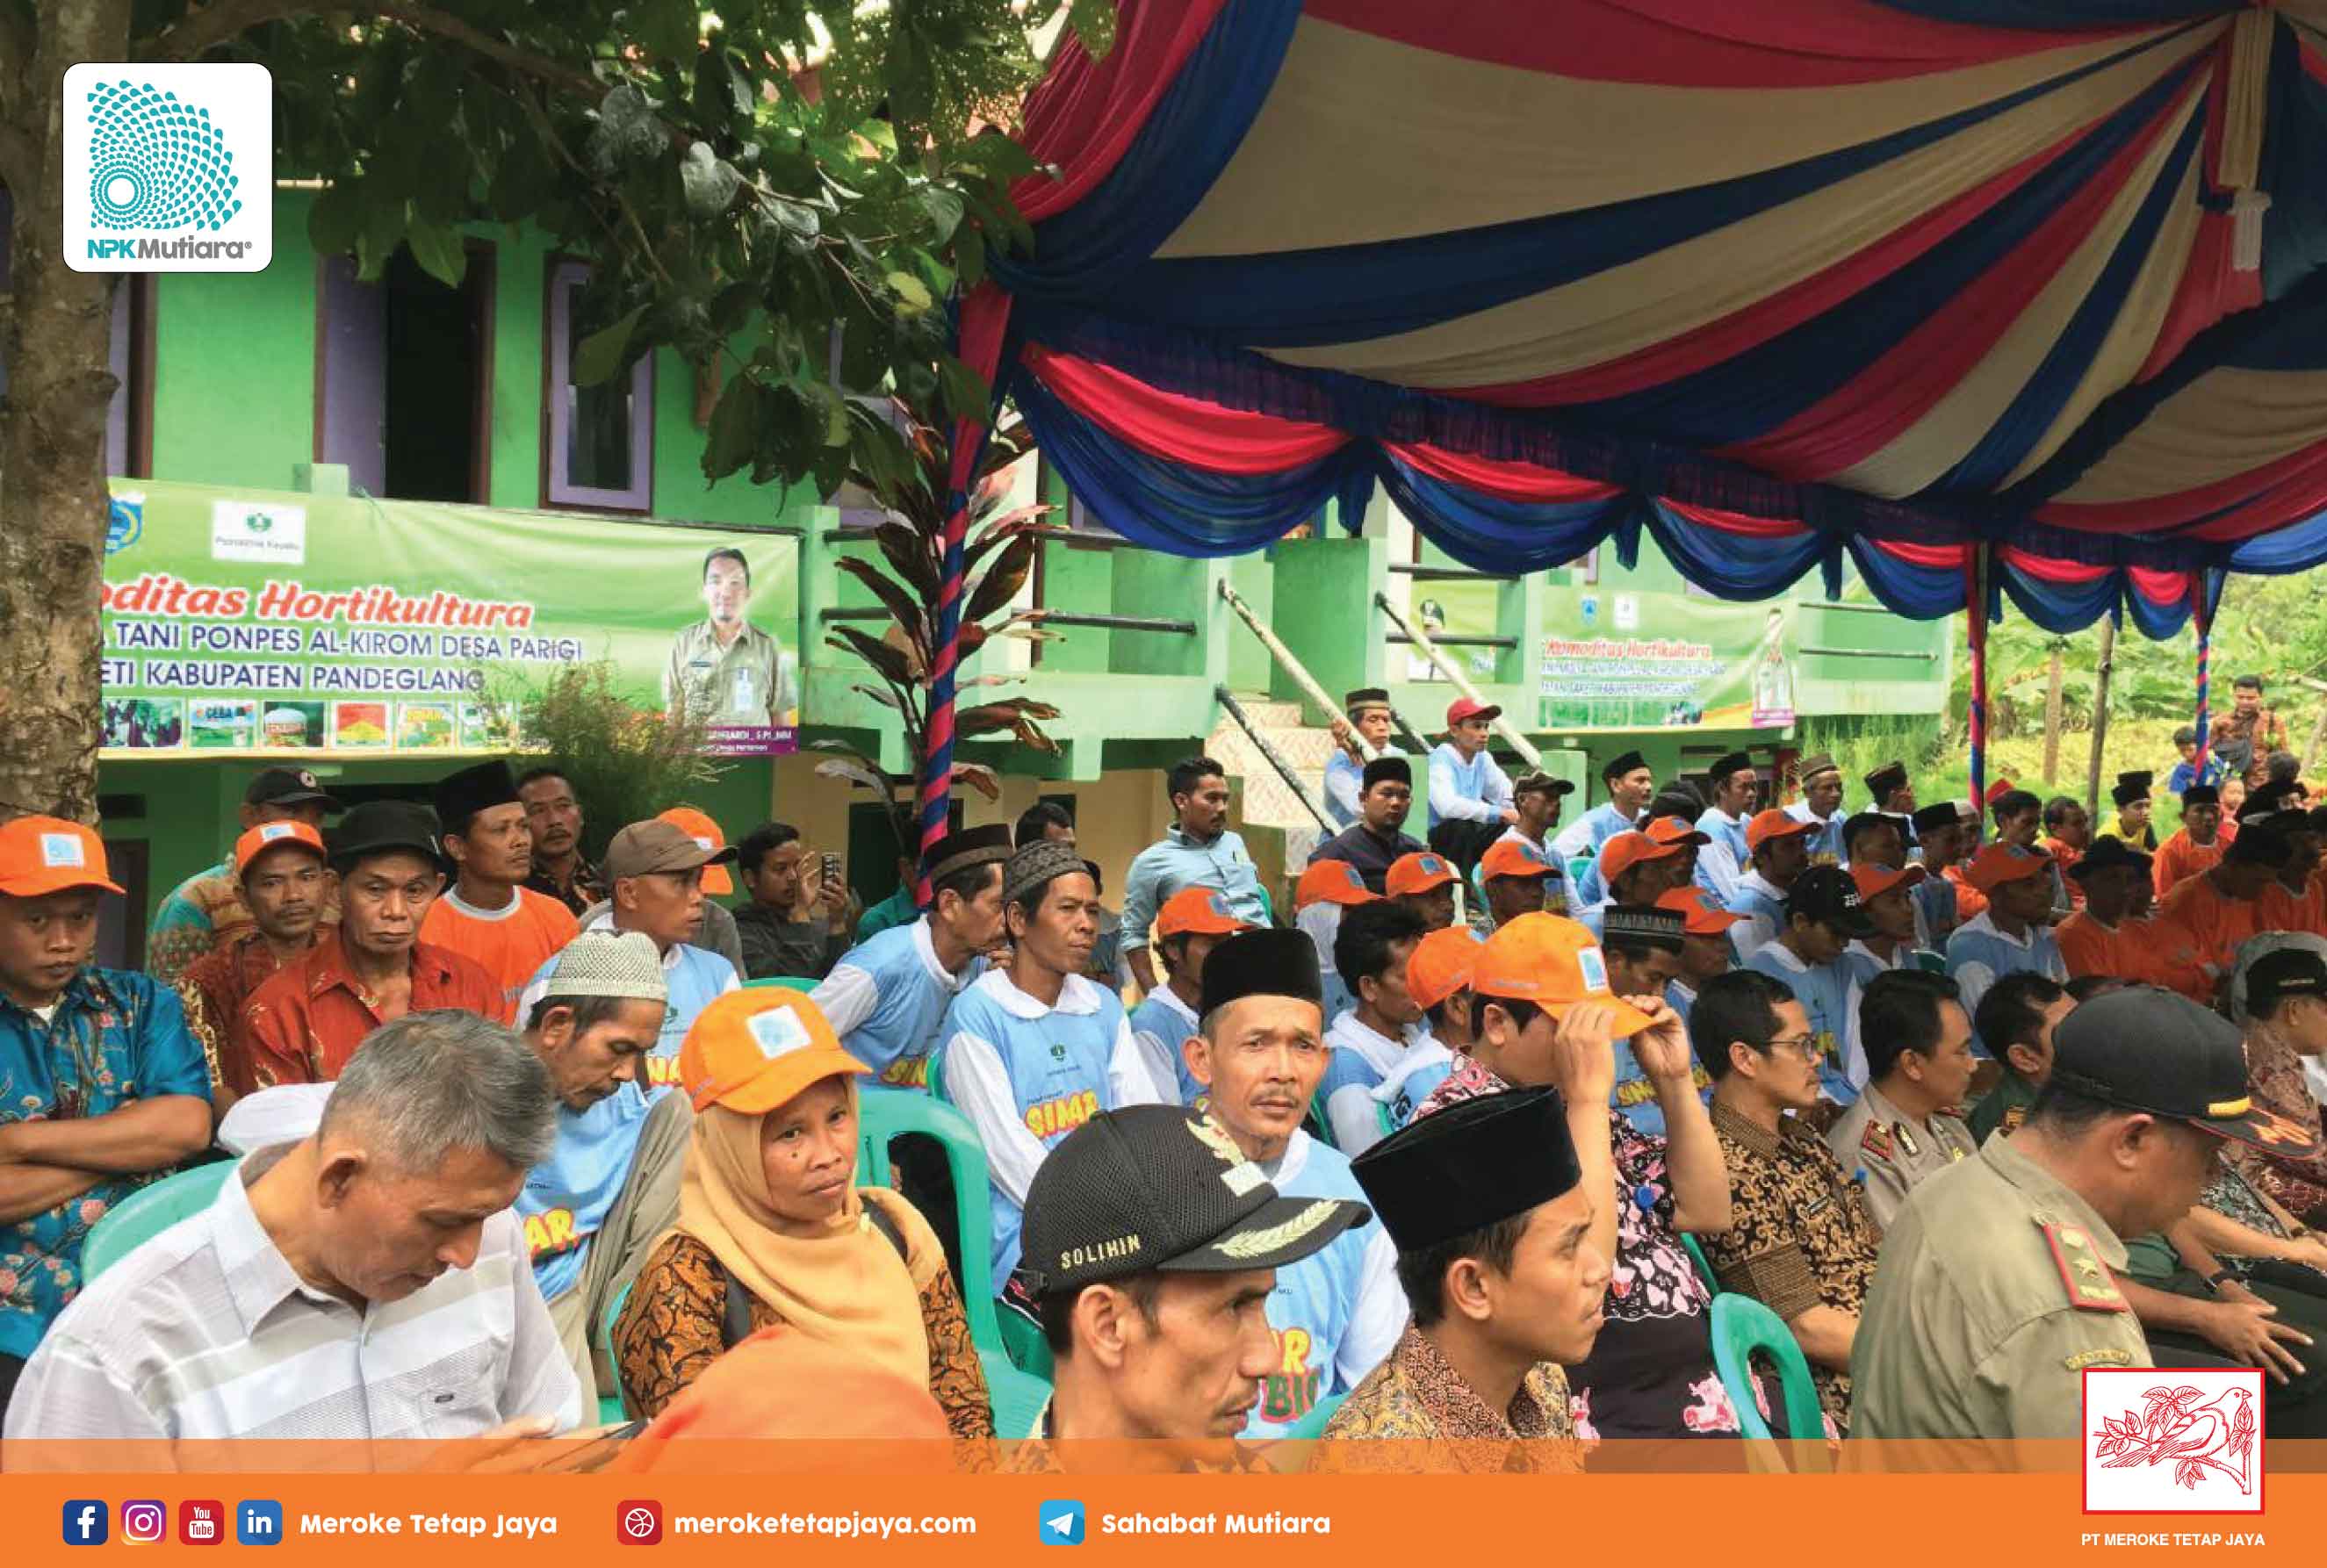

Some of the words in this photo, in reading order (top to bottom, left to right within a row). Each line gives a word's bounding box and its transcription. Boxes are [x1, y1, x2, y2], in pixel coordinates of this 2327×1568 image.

[259, 582, 533, 627] Hortikultura
[116, 622, 179, 647] TANI
[191, 625, 300, 651] PONPES
[310, 629, 432, 655] AL-KIROM
[442, 636, 502, 658] DESA
[509, 637, 582, 661] PARIGI
[101, 660, 133, 685] ETI
[147, 661, 302, 687] KABUPATEN
[313, 666, 485, 691] PANDEGLANG
[522, 1208, 576, 1251] AR
[1060, 1234, 1141, 1270] SOLIHIN
